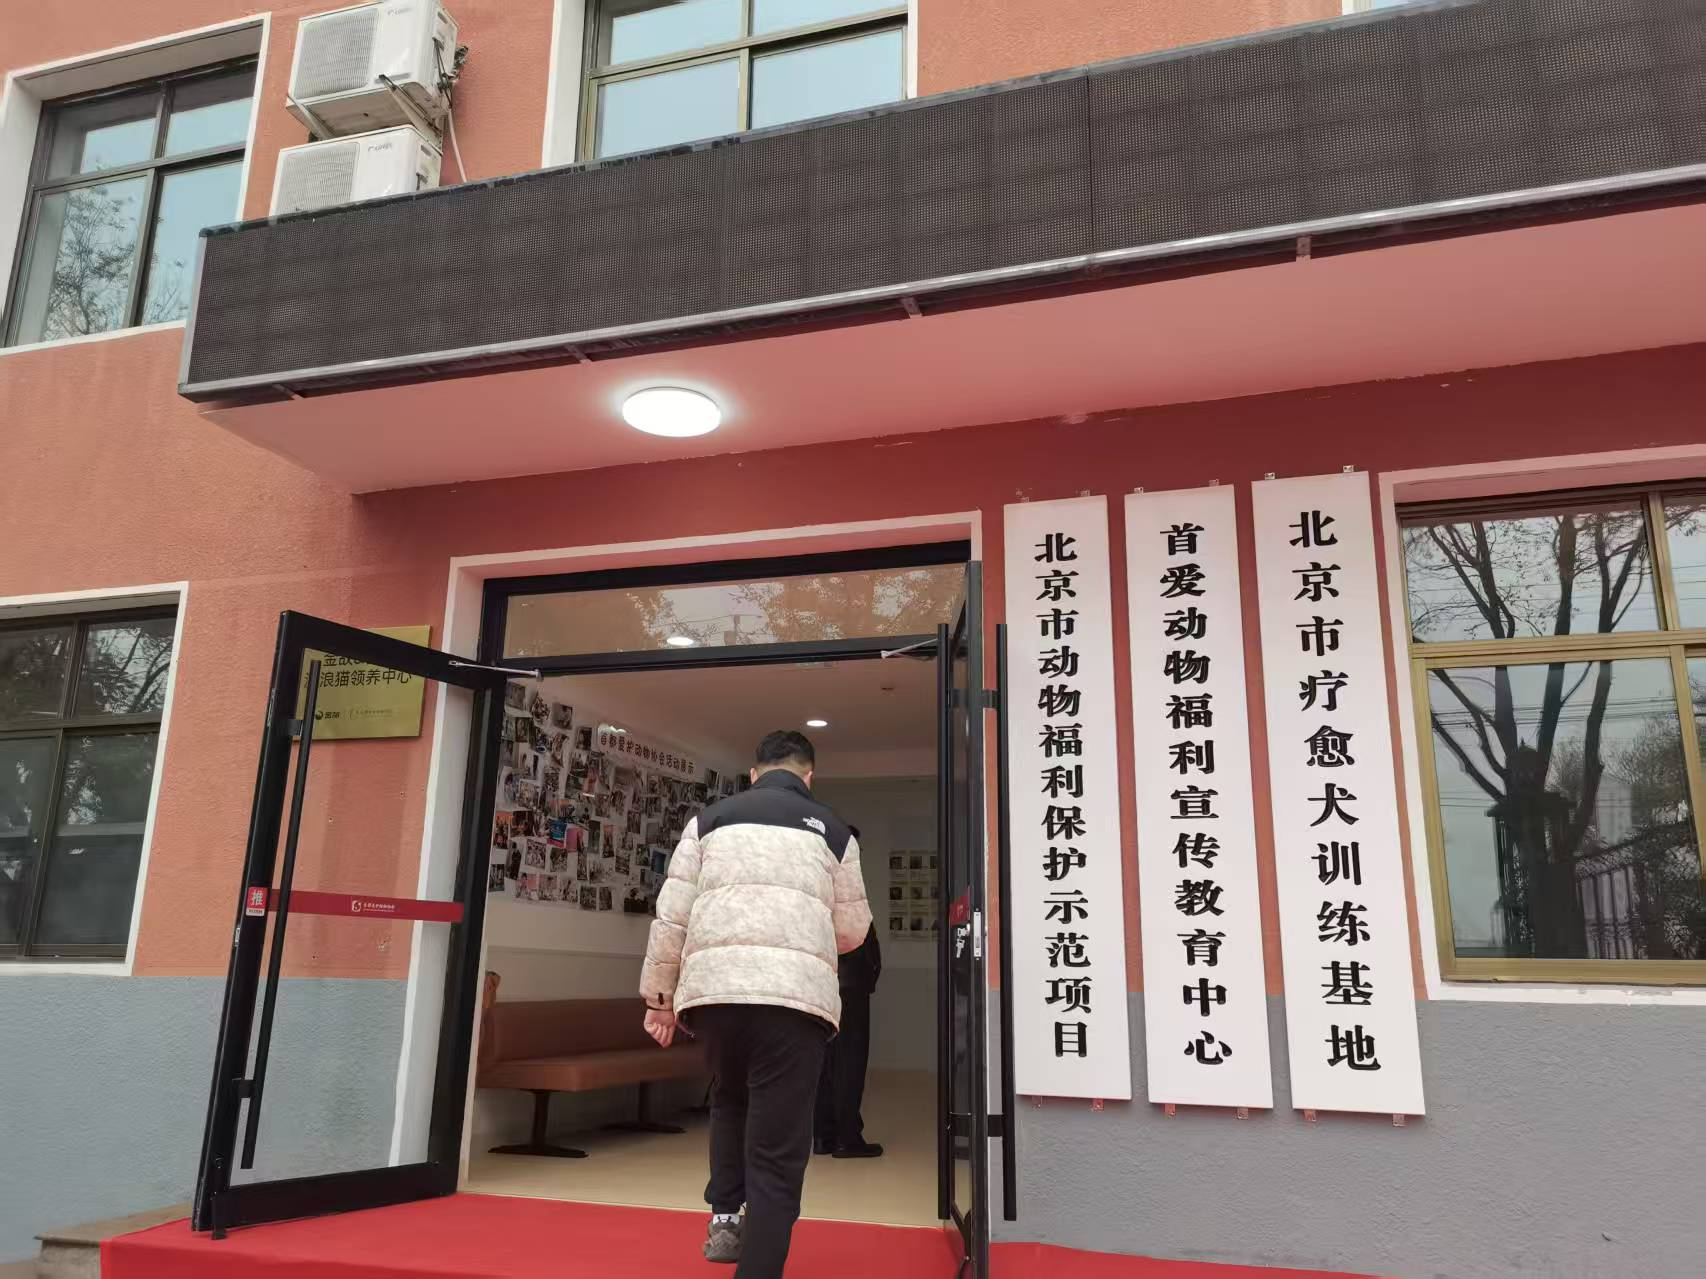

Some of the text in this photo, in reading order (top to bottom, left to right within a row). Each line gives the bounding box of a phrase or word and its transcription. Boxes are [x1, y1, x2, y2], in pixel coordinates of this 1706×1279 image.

[251, 889, 263, 905] 推
[1034, 532, 1093, 1058] 北京市动物福利保护示范项目
[1159, 523, 1233, 1066] 首爱动物福利宣传教育中心
[1289, 510, 1382, 1072] 北京市疗愈犬训练基地
